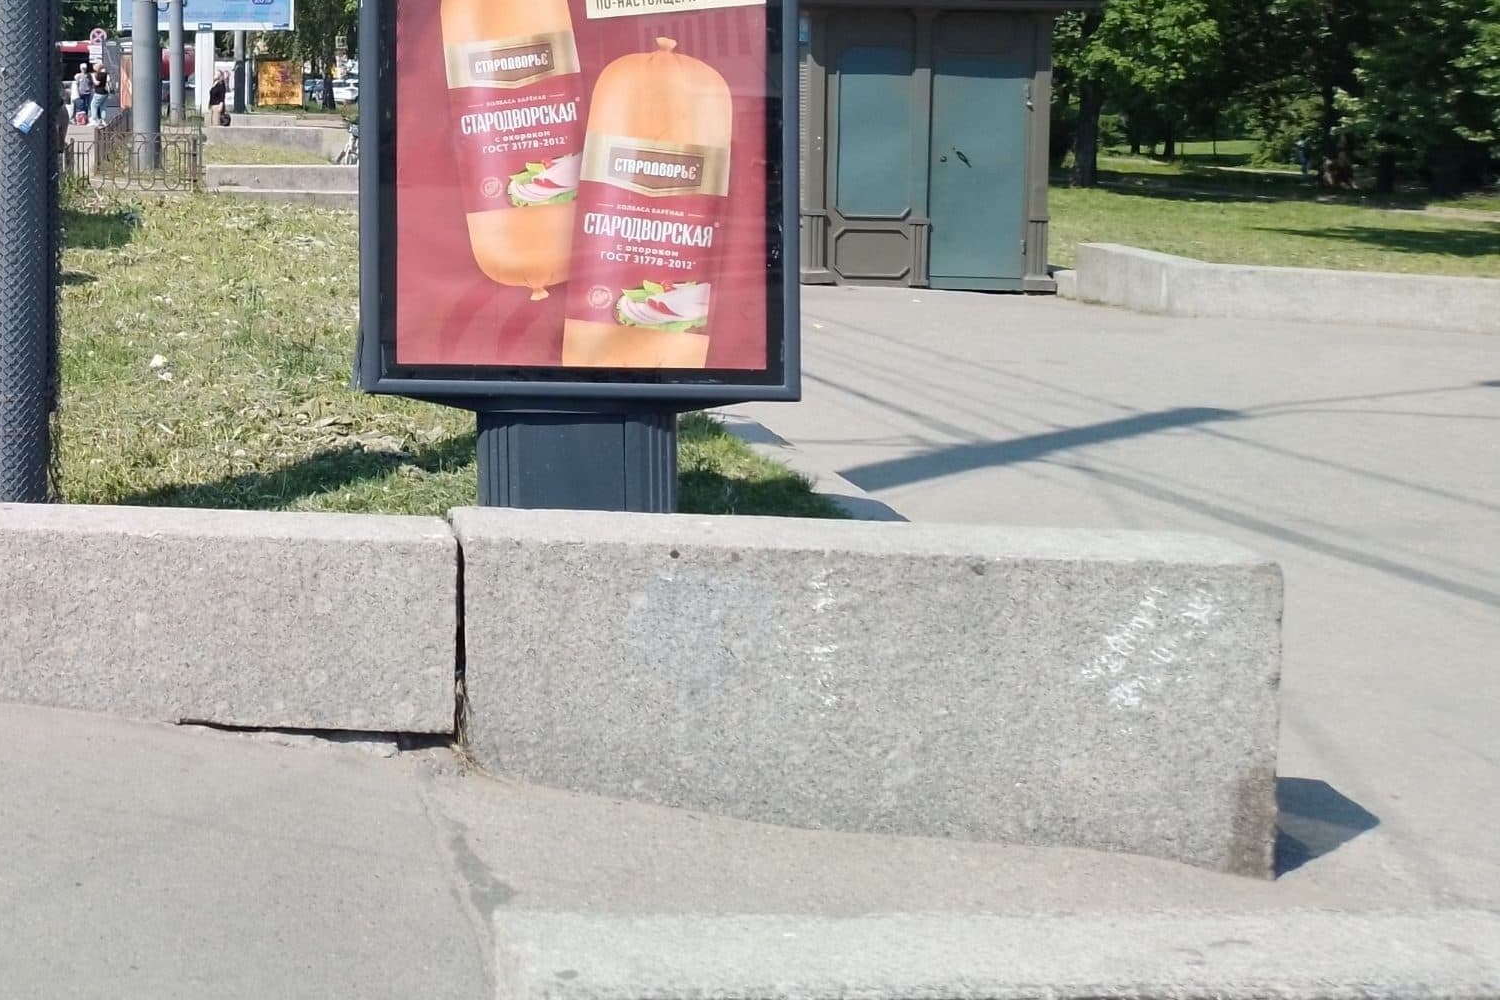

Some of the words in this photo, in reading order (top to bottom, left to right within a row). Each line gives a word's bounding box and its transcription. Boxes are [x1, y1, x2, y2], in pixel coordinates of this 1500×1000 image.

[461, 101, 577, 135] СТАРОДВОРСКАЯ
[502, 130, 551, 142] окороком
[482, 143, 509, 154] ГОСТ
[583, 212, 713, 248] СТАРОДВОРСКАЯ
[600, 251, 631, 262] ГОСТ
[625, 245, 679, 257] окороком
